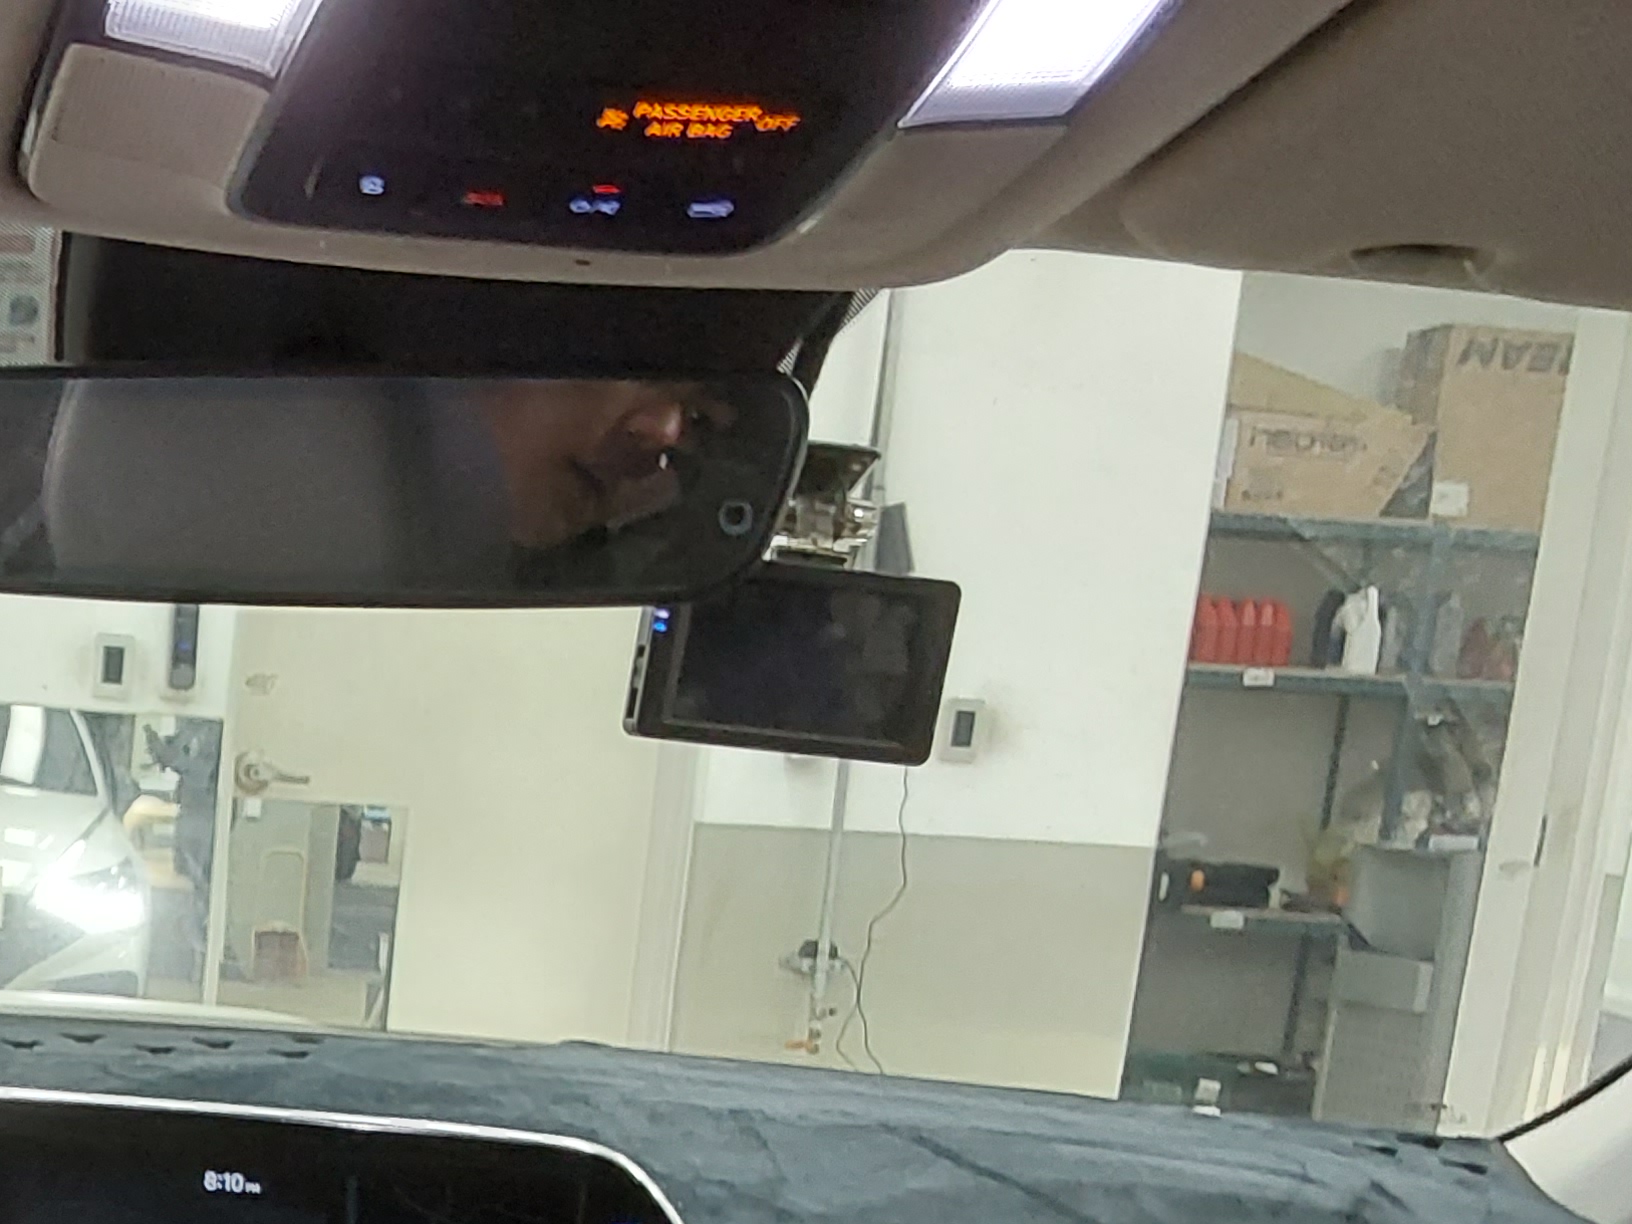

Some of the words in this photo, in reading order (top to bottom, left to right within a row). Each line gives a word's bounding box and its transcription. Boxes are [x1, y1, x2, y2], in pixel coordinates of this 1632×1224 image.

[633, 101, 764, 122] PASSENGER
[755, 115, 801, 131] OFF
[644, 121, 684, 137] AIR
[203, 1169, 244, 1193] 8:10
